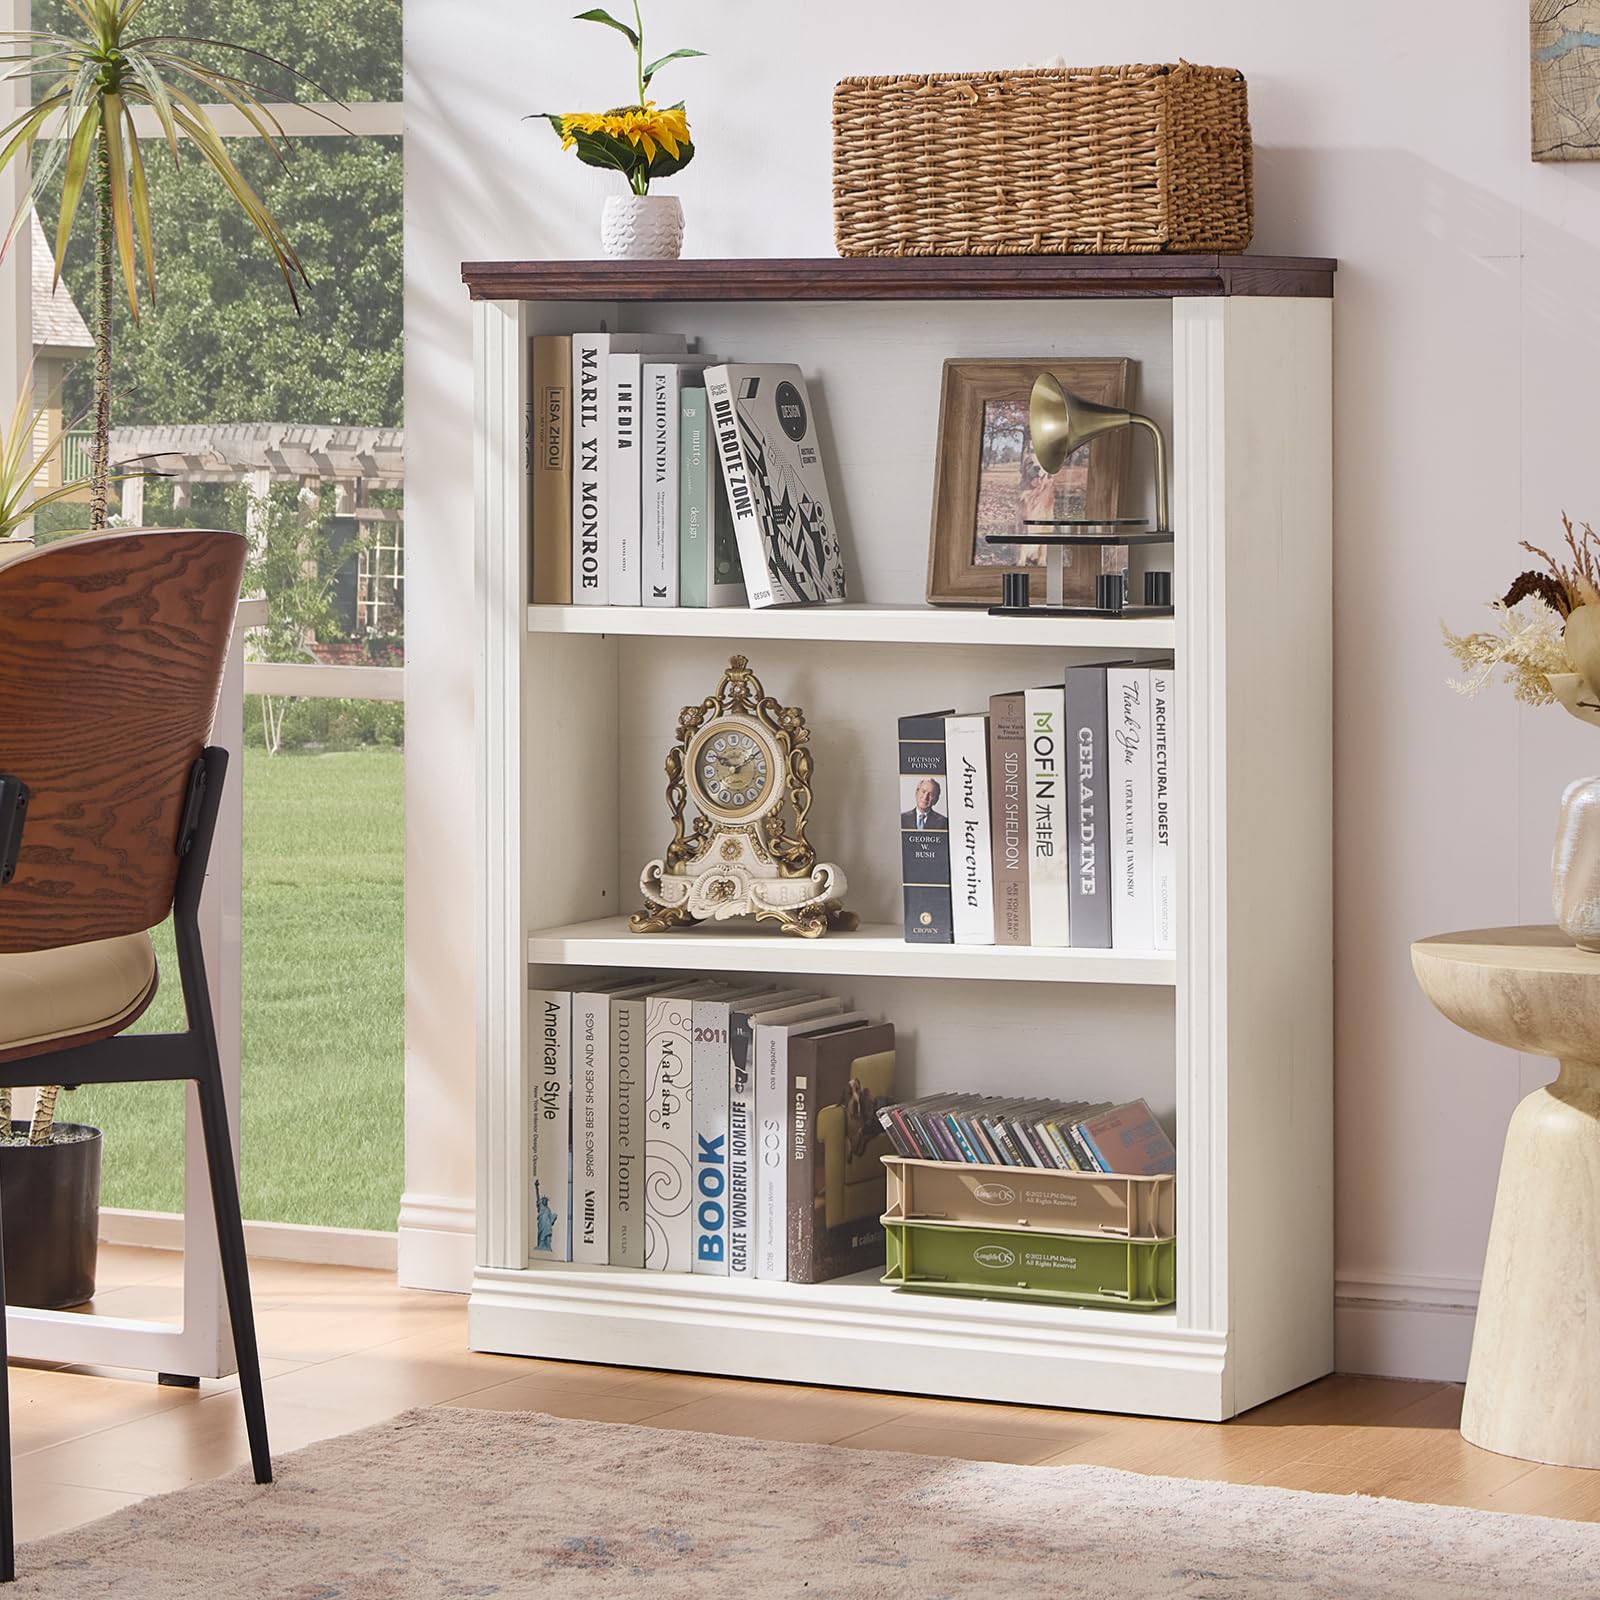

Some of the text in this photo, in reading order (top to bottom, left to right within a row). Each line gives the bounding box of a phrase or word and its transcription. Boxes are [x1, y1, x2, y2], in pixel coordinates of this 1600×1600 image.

[549, 391, 561, 466] LISA ZHOU
[617, 383, 632, 449] INEDIA
[655, 375, 666, 483] FASHIONINDIA
[713, 399, 734, 429] DIE
[581, 348, 598, 588] MARIL YN MONROE
[692, 430, 701, 466] muuto
[720, 430, 744, 475] ROTE
[688, 506, 700, 539] design
[730, 474, 754, 521] ZONE
[653, 585, 667, 598] K
[1122, 680, 1140, 728] Thank
[1115, 722, 1140, 765] You
[1155, 678, 1169, 847] AD ARCHITECTURAL DIGEST
[961, 756, 980, 908] Anna karenina
[1003, 751, 1020, 870] SIDNEY SHELDON
[1035, 804, 1054, 858] 木非尼
[908, 835, 941, 843] GEORGE
[1006, 886, 1013, 896] OF
[1012, 914, 1020, 941] AFRAID
[540, 1001, 561, 1120] American Style
[694, 1027, 727, 1044] 2011
[768, 1040, 777, 1076] magazine
[585, 1012, 595, 1177] SPRING'S BEST SHOES AND BAGS
[619, 1009, 635, 1148] monochrome
[661, 1040, 672, 1130] Madame
[764, 1119, 780, 1168] COS
[619, 1152, 635, 1212] home
[697, 1133, 725, 1263] BOOK
[732, 1101, 747, 1272] CREATE WONDERFUL HOMELIFE
[583, 1189, 596, 1245] FASHION
